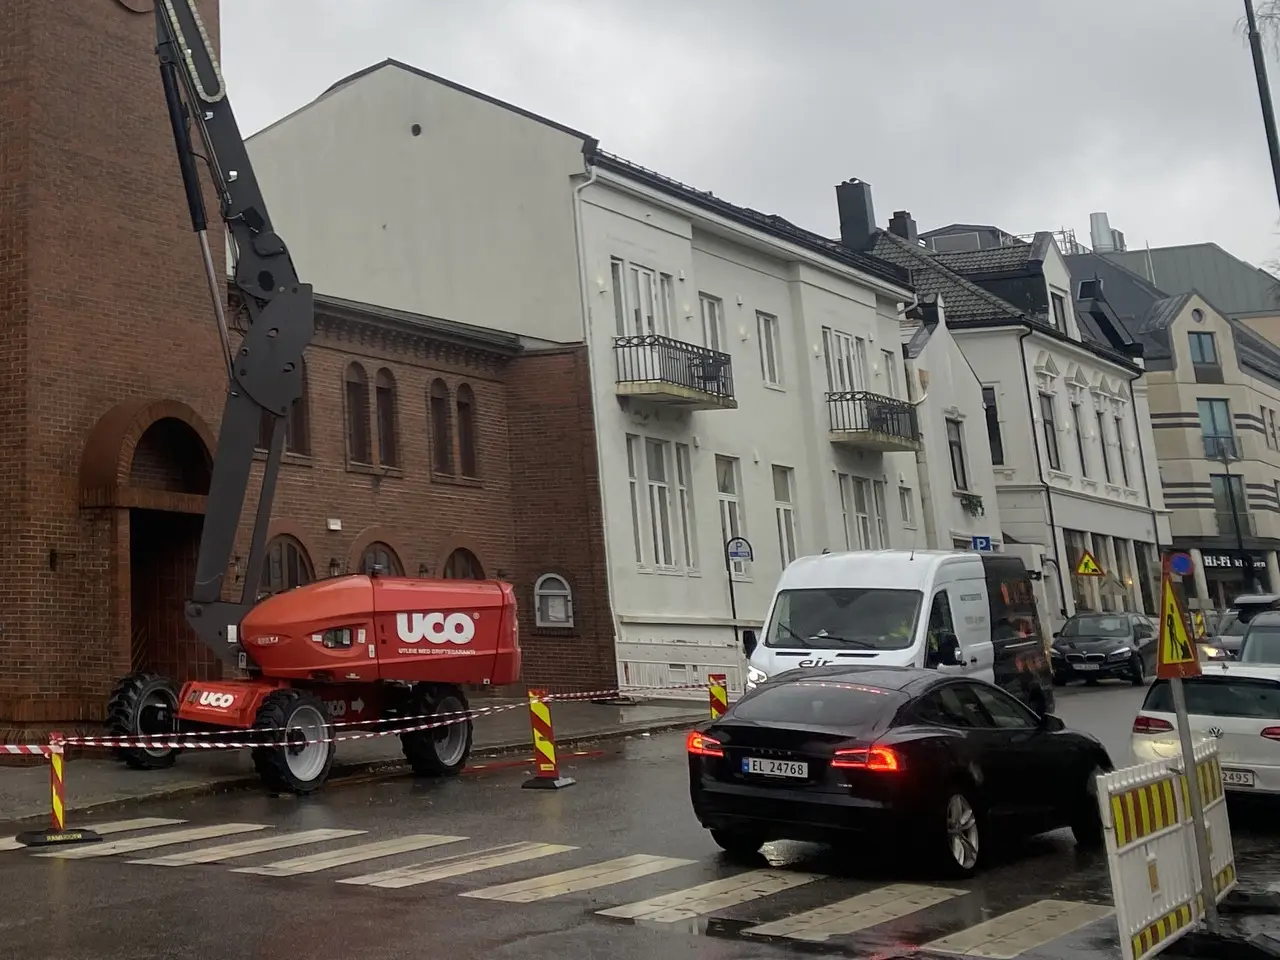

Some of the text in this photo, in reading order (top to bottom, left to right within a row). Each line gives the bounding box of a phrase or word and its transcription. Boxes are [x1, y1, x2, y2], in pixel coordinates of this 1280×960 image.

[977, 538, 986, 550] P
[1204, 556, 1266, 567] Hi-Fi klen
[396, 612, 475, 644] UCO
[199, 691, 234, 708] UCO
[752, 760, 804, 775] EL 24768
